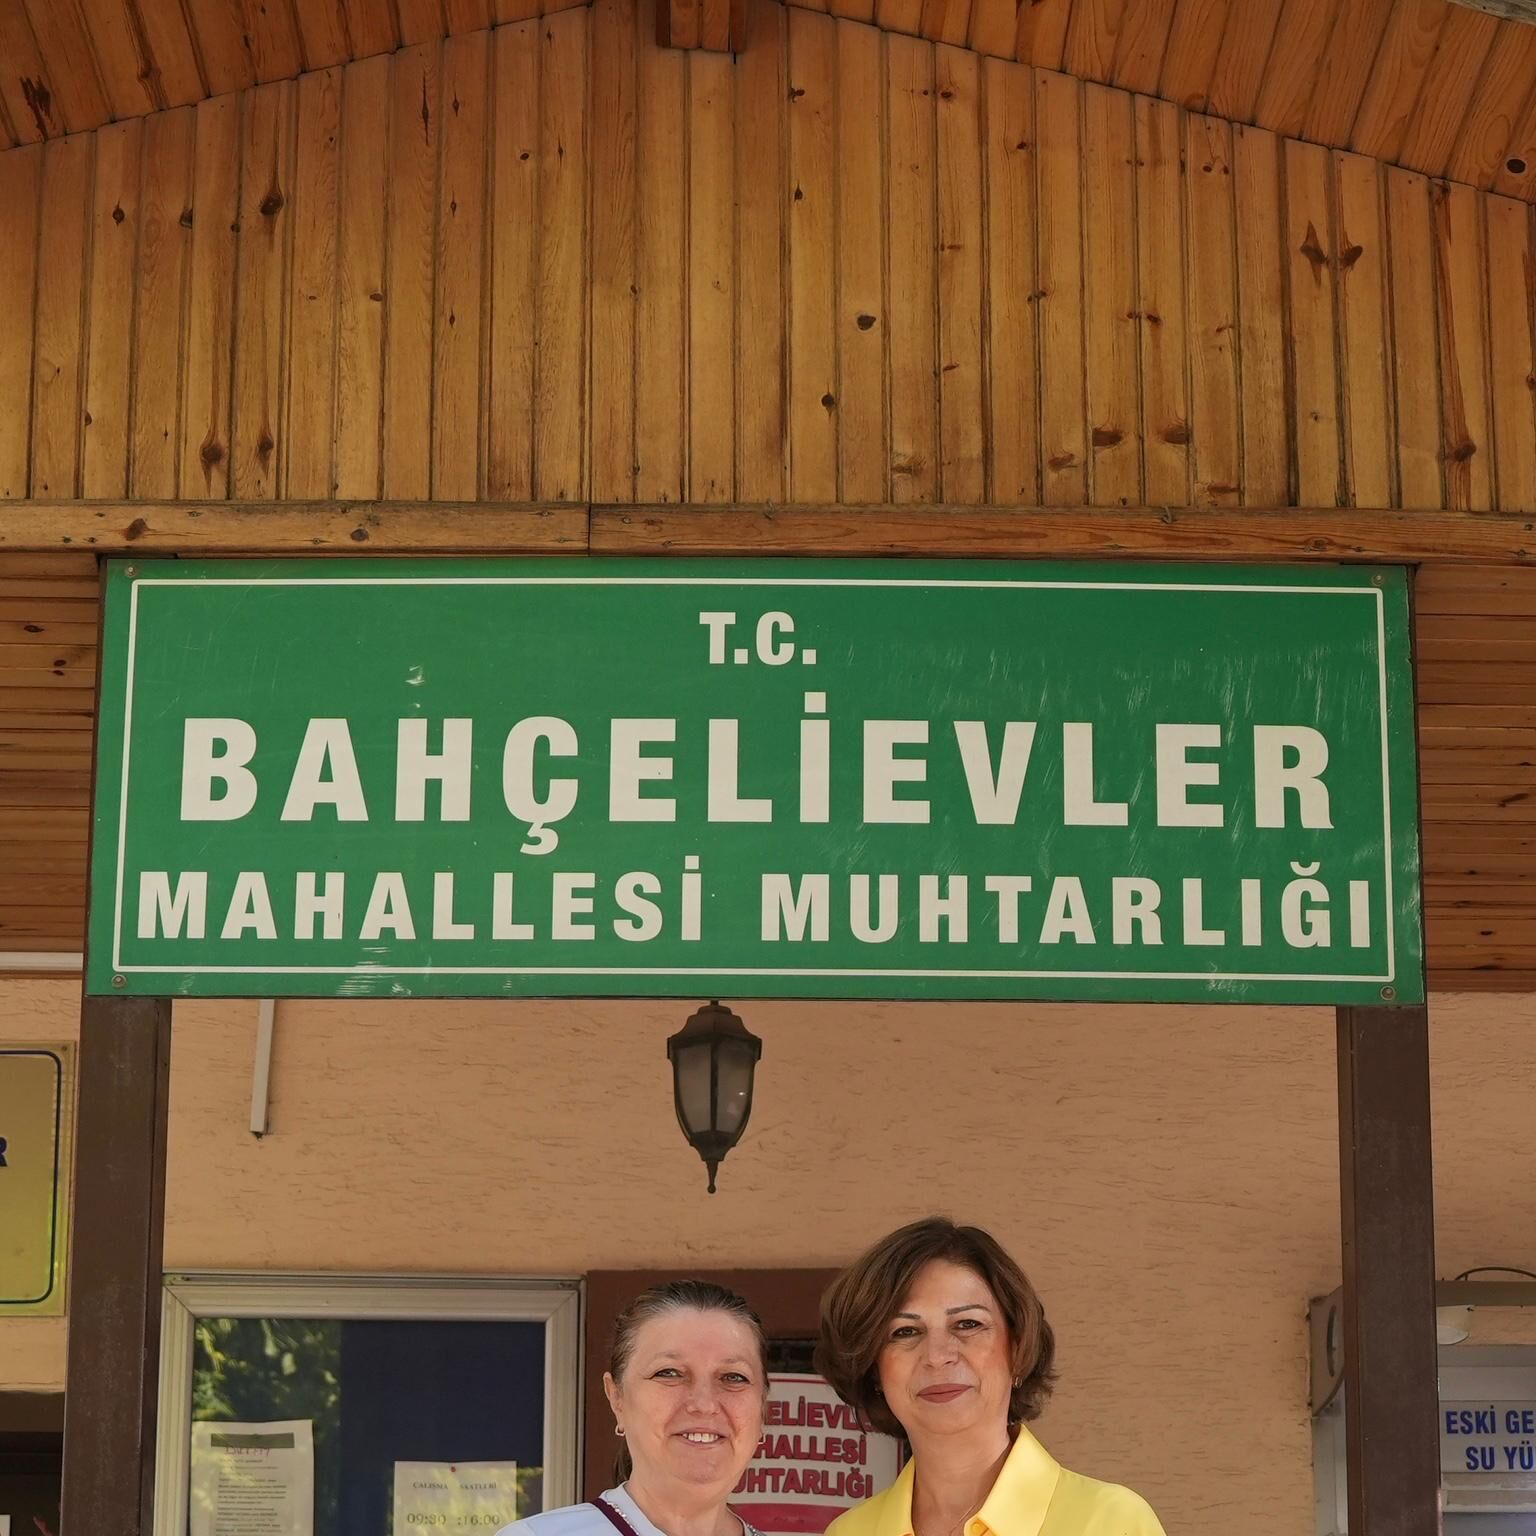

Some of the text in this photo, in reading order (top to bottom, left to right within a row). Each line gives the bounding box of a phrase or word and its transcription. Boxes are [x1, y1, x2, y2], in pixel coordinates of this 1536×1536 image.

[699, 610, 818, 667] T.C.
[178, 690, 1335, 856] BAHÇELİEVLER
[135, 854, 1373, 949] MAHALLESİ MUHTARLIĞI
[764, 1395, 873, 1433] ELİEVL
[1445, 1405, 1497, 1435] ESKİ
[752, 1433, 868, 1466] HALLESİ
[1465, 1445, 1495, 1471] SU
[731, 1466, 874, 1500] UHTARLIĞI
